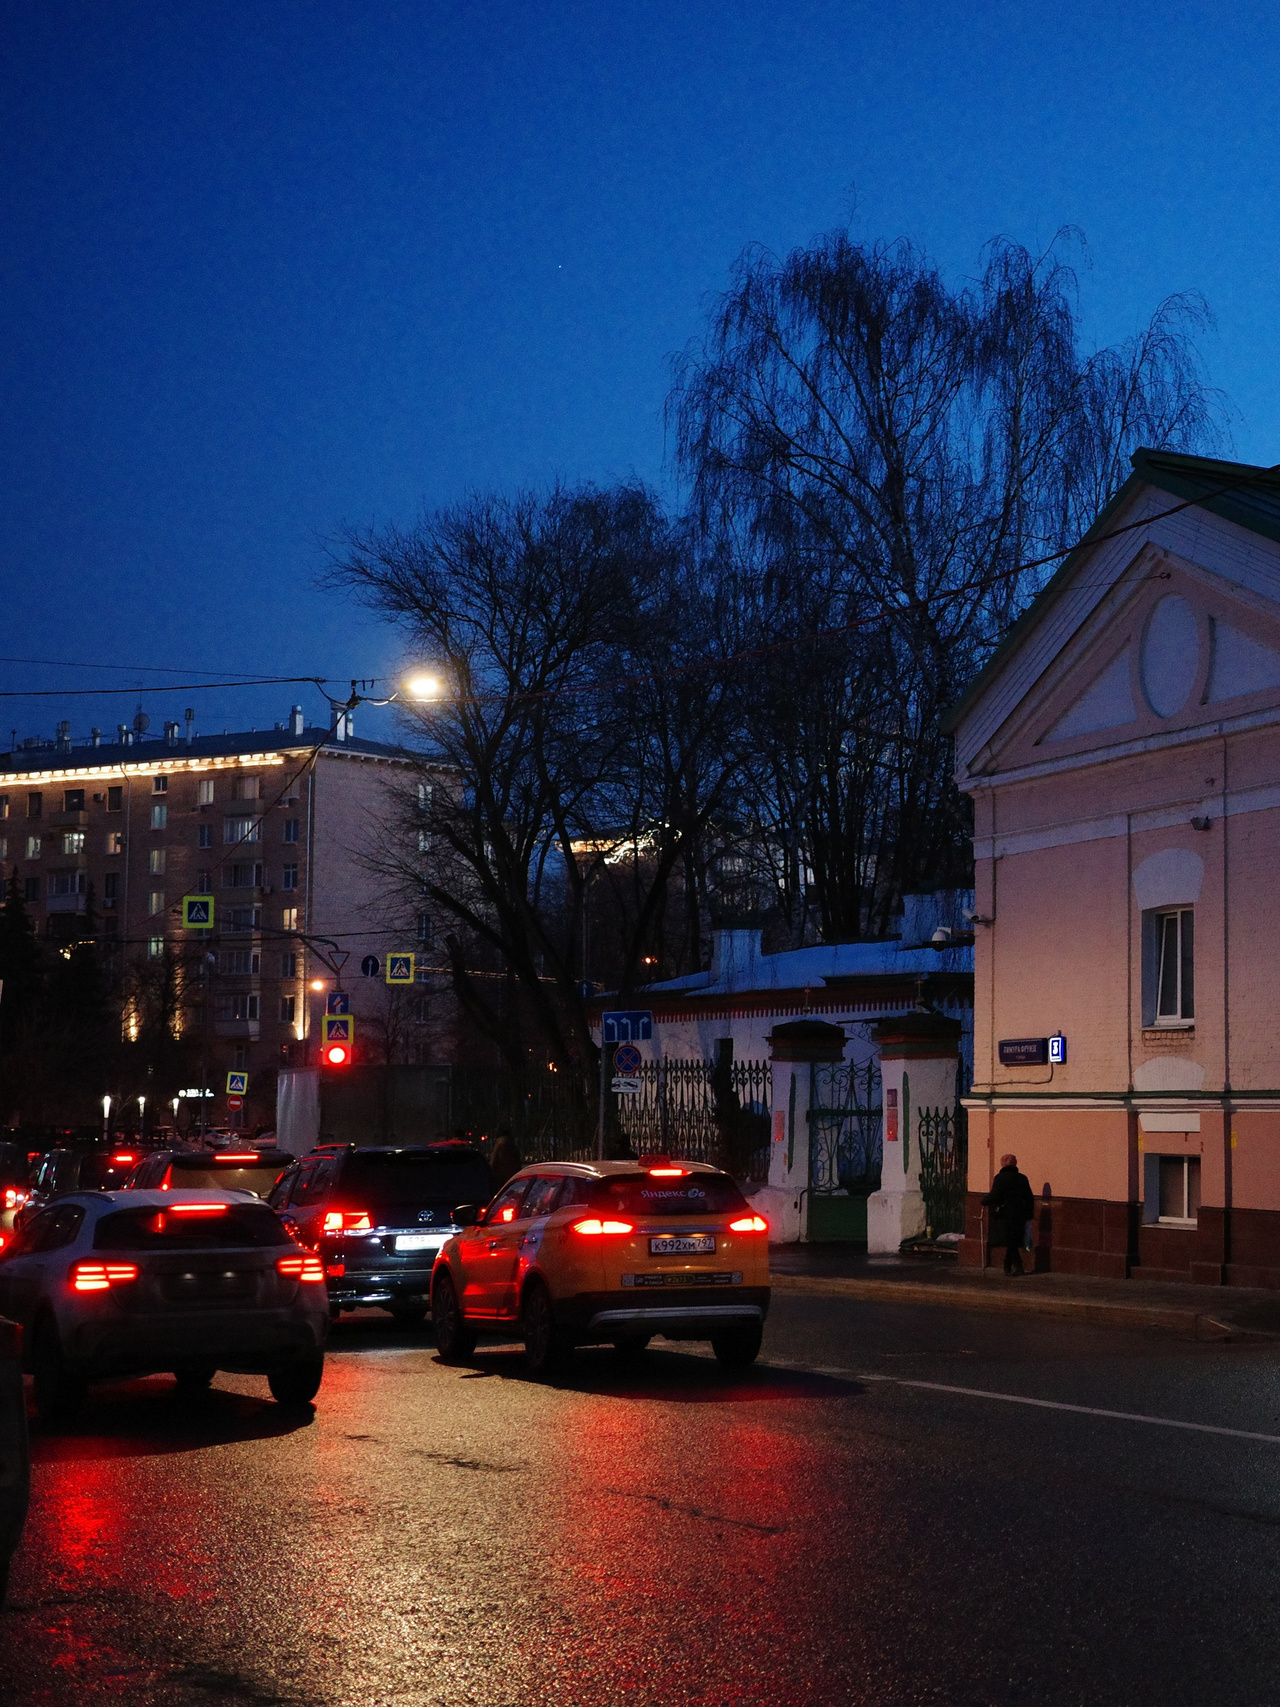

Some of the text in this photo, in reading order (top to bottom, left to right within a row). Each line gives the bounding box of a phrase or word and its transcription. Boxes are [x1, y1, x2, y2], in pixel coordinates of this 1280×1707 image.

[1052, 1041, 1058, 1055] 3
[641, 1187, 705, 1199] Яндекс Go
[696, 1238, 712, 1247] 797
